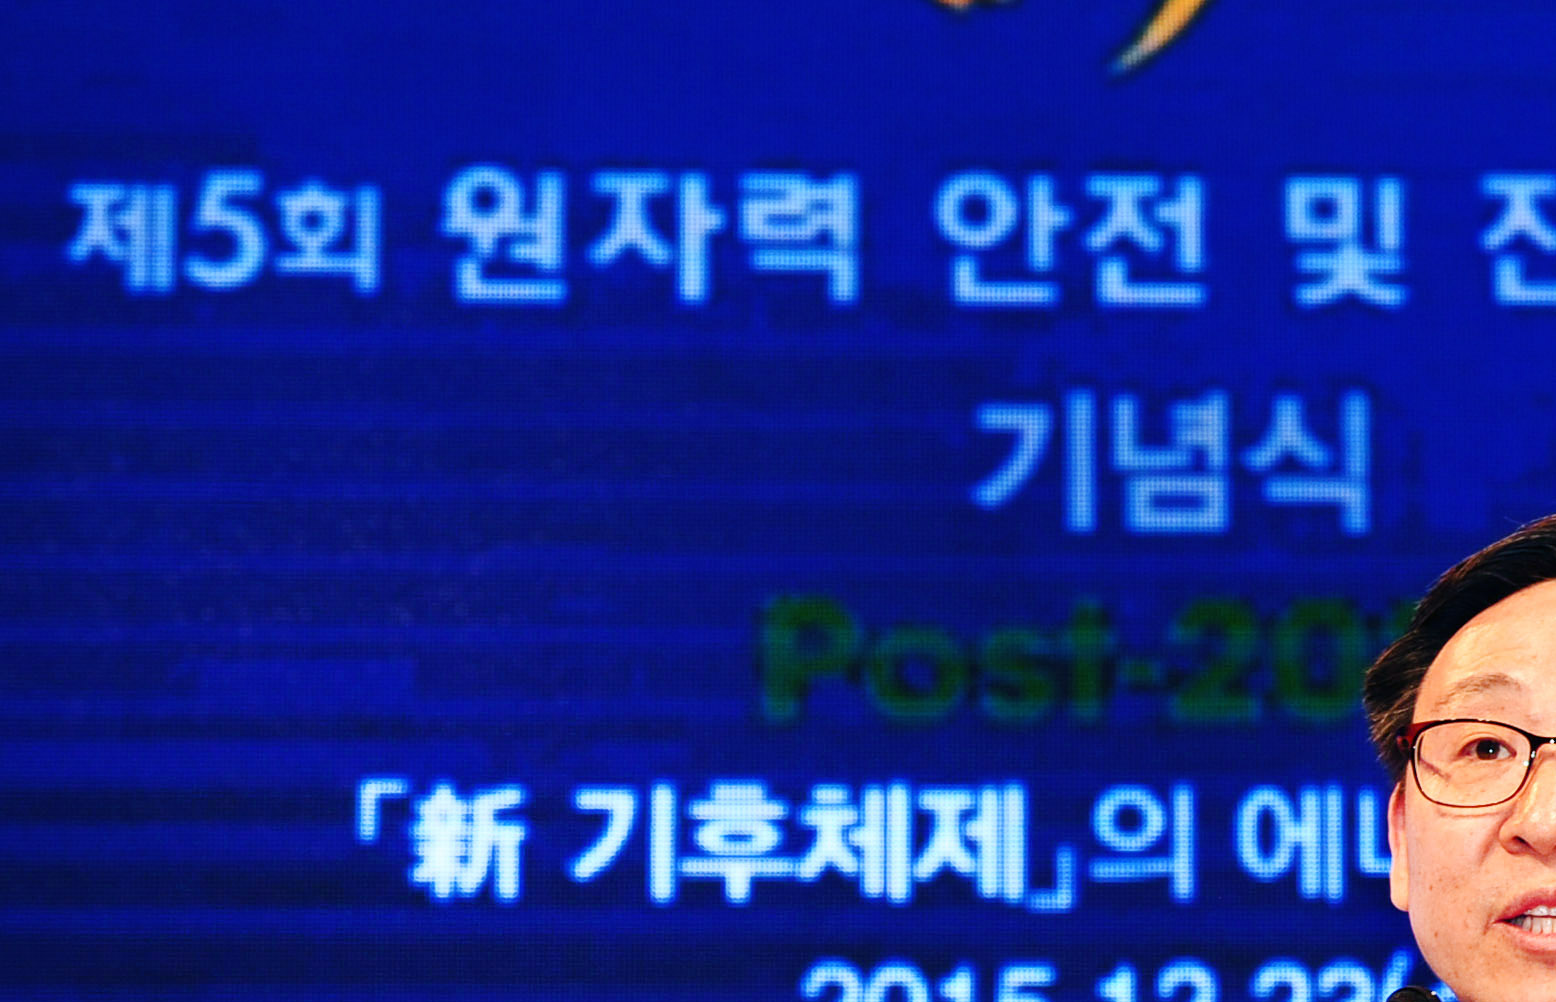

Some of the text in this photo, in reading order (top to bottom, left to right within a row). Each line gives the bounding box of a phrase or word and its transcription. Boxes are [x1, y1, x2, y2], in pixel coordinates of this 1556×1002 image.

[69, 171, 380, 291] 제5회
[441, 164, 860, 304] 원자력
[934, 171, 1205, 307] 안전
[1283, 175, 1406, 308] 및
[970, 391, 1370, 534] 기념식
[762, 596, 1416, 720] Post-20
[567, 777, 1197, 912] 기후체제」의
